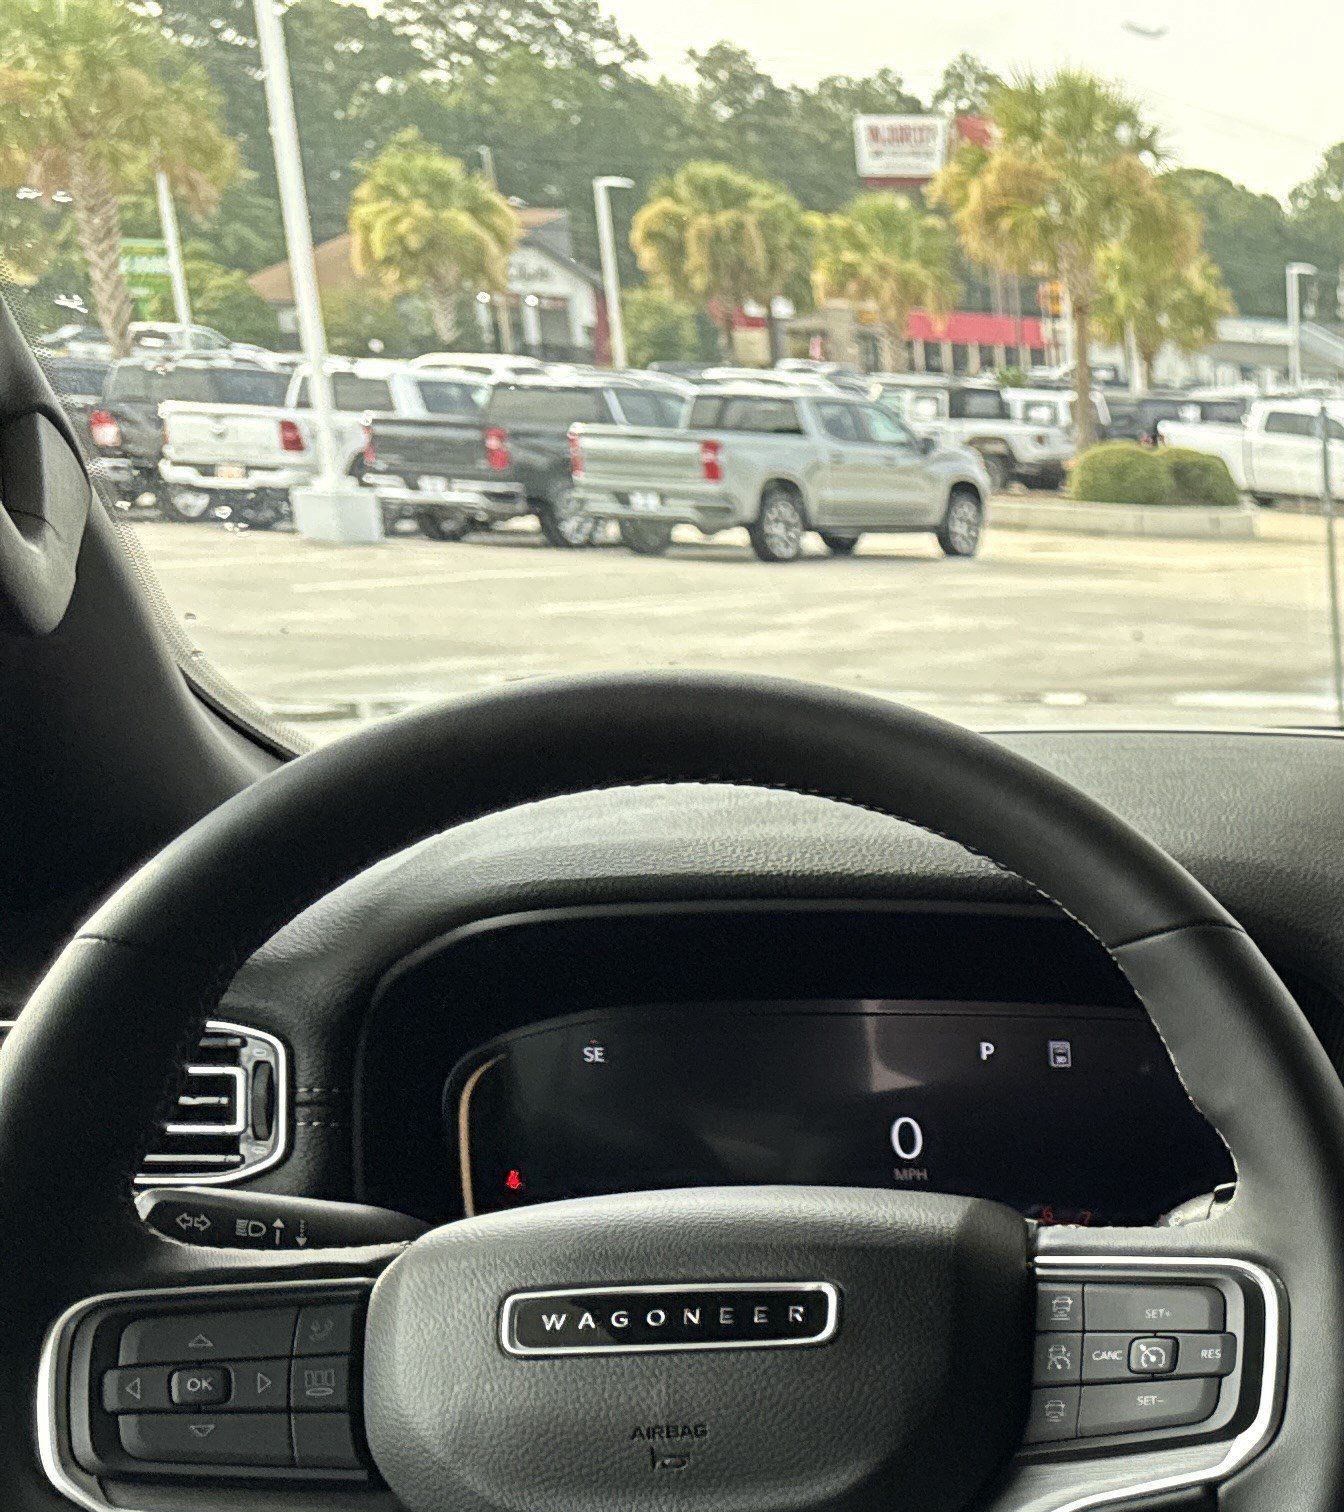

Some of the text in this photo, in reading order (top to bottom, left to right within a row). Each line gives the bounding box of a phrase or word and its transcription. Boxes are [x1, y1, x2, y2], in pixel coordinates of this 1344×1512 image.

[583, 1046, 605, 1063] SE
[979, 1041, 995, 1061] P
[890, 1116, 923, 1160] 0
[893, 1167, 928, 1181] MPH
[541, 1306, 806, 1331] WAGONEER
[1092, 1349, 1123, 1361] CANC
[1200, 1348, 1222, 1360] RES
[186, 1377, 213, 1392] OK
[630, 1423, 709, 1441] AIRBAG
